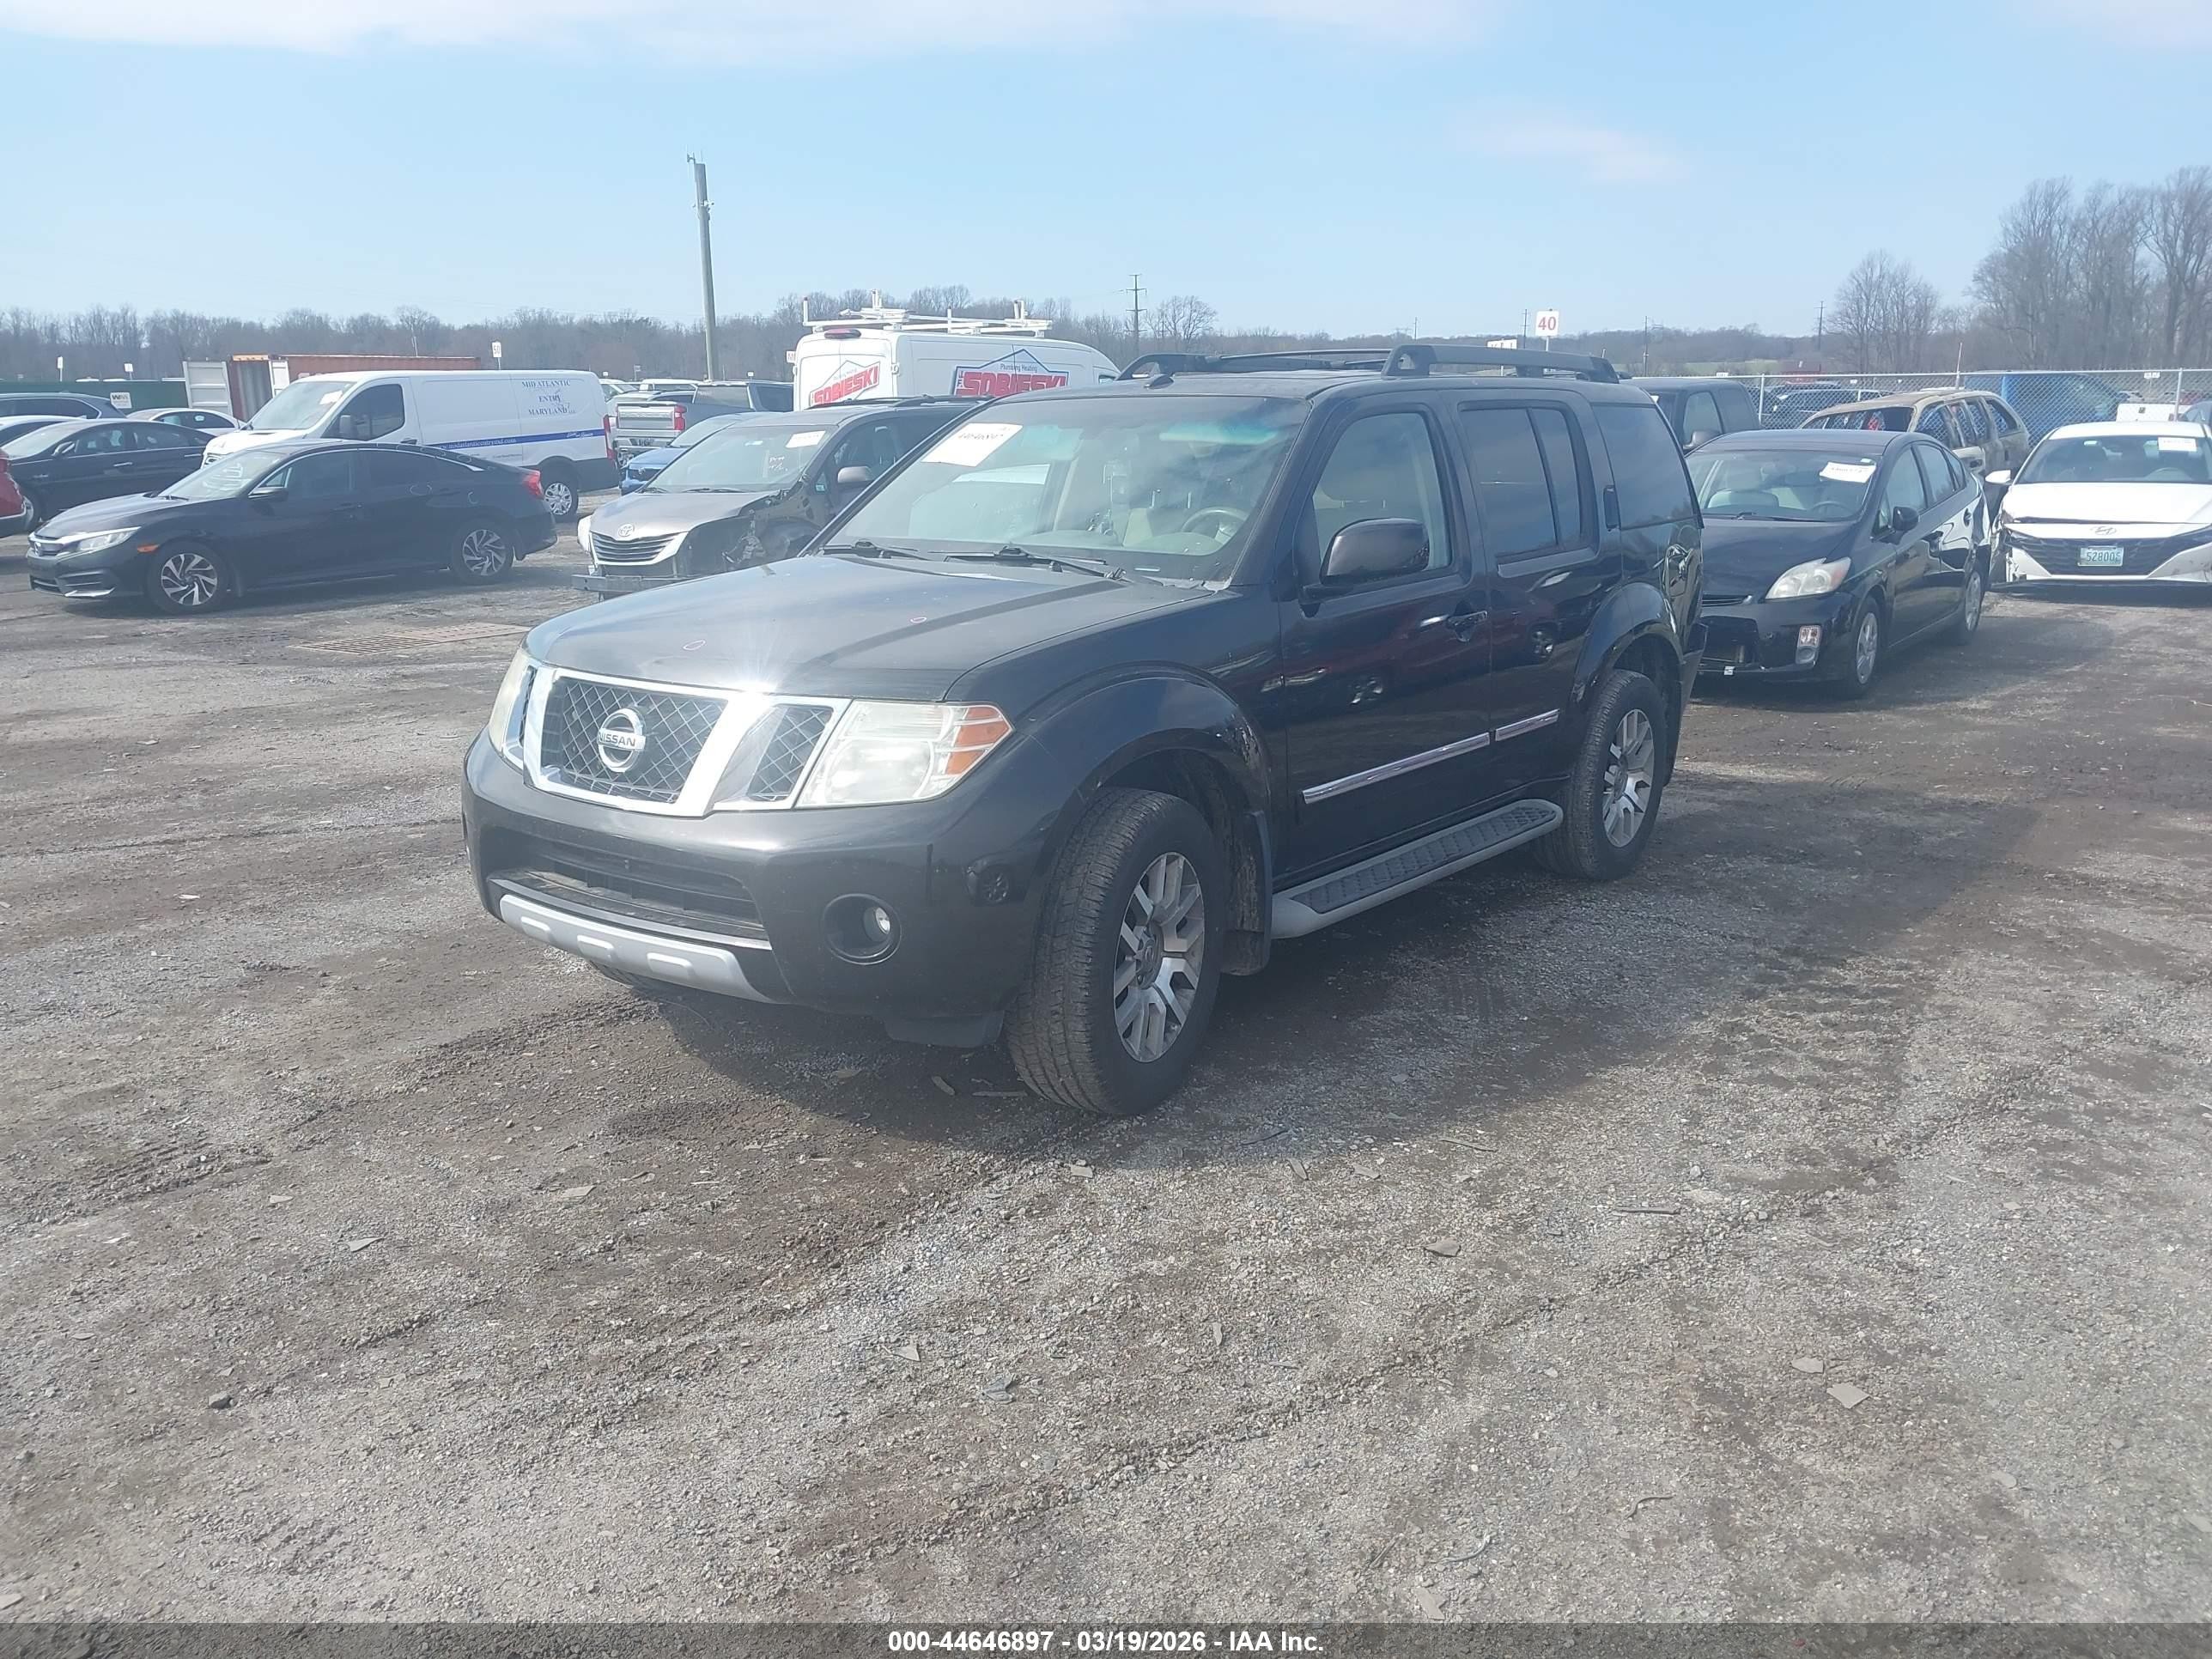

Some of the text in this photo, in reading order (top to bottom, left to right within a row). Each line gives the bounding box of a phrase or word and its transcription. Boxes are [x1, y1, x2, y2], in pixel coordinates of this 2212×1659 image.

[1538, 316, 1557, 331] 40
[1000, 363, 1038, 373] Plumbing Heating
[814, 365, 878, 404] SOBIESKI
[528, 407, 568, 416] MARYLAND
[599, 732, 636, 747] NISSAN
